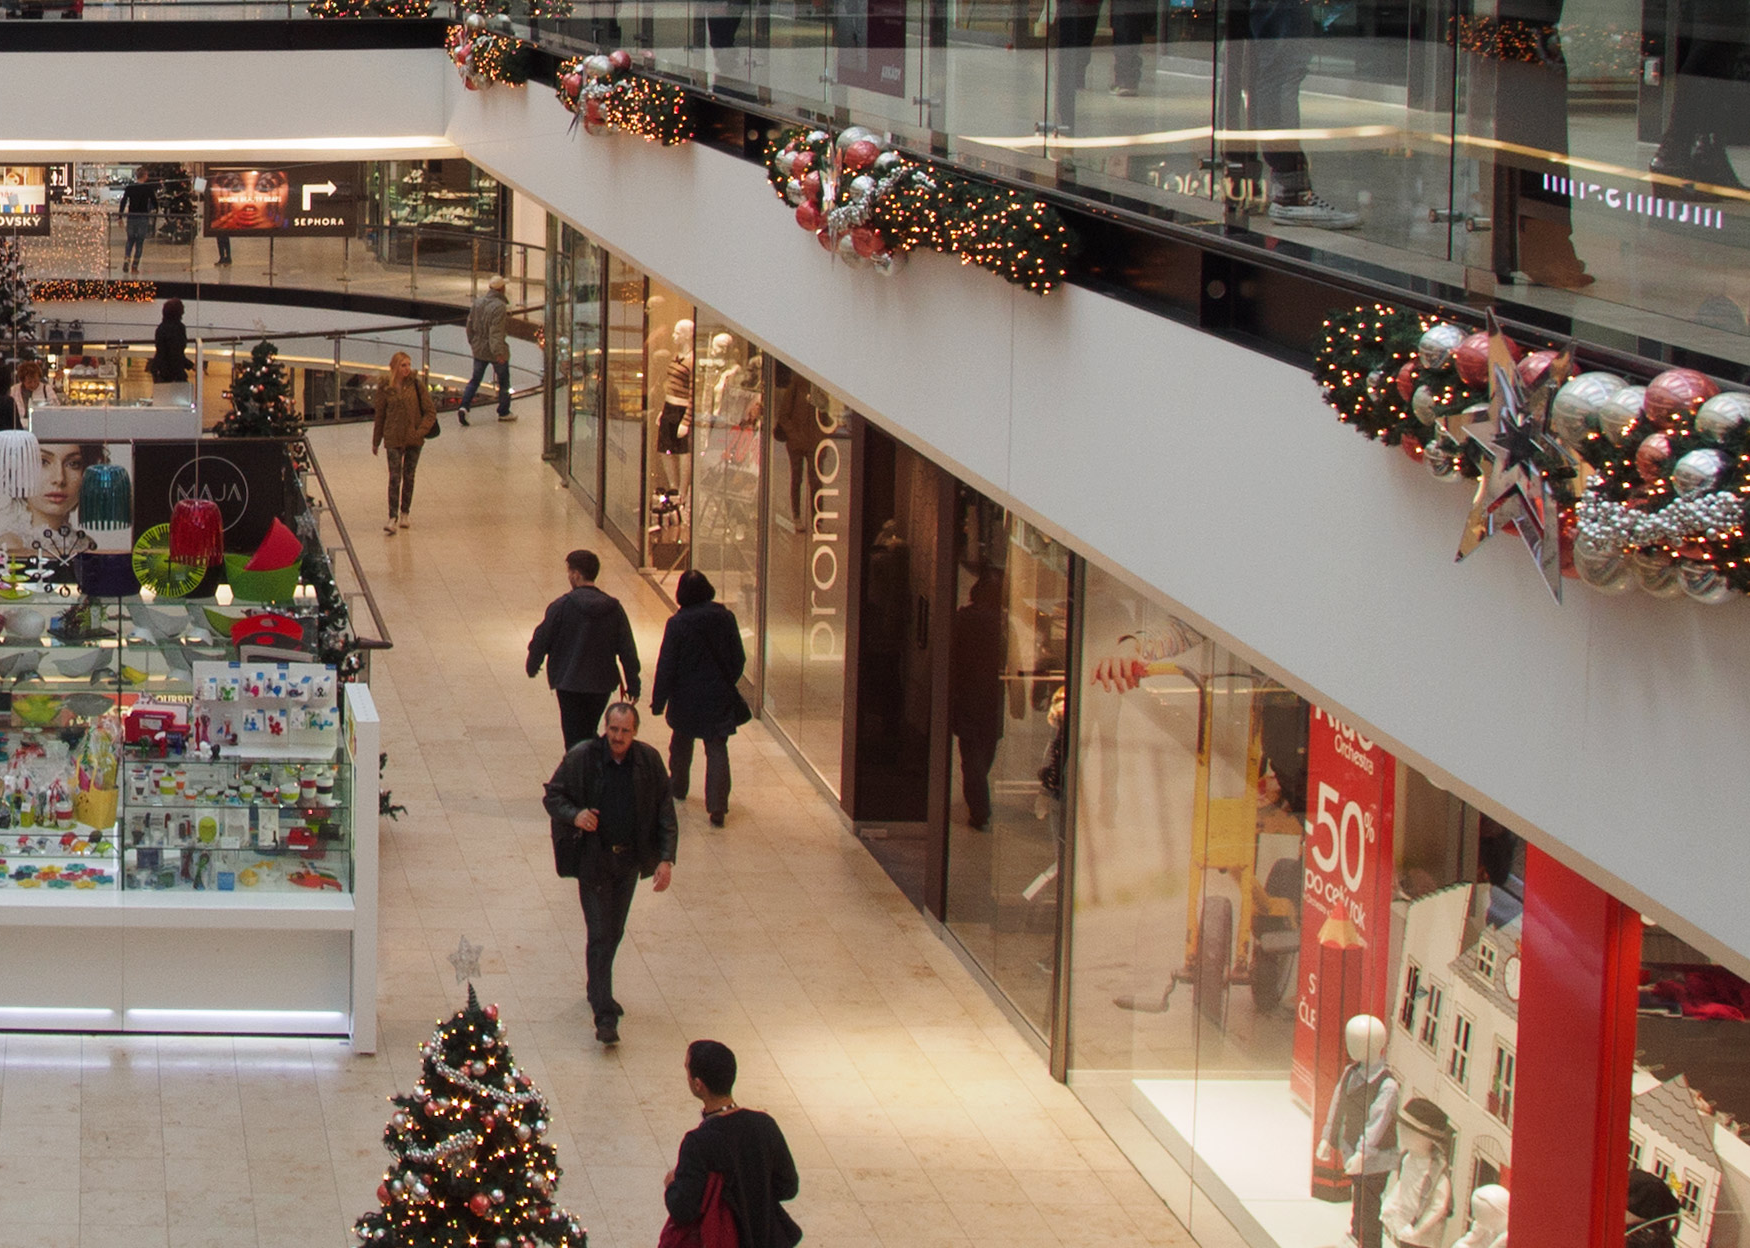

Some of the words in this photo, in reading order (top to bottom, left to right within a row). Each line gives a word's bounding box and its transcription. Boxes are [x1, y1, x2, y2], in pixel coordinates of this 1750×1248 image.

[294, 217, 345, 227] SEPHORA
[177, 483, 242, 502] MAJA
[1305, 867, 1323, 895] po
